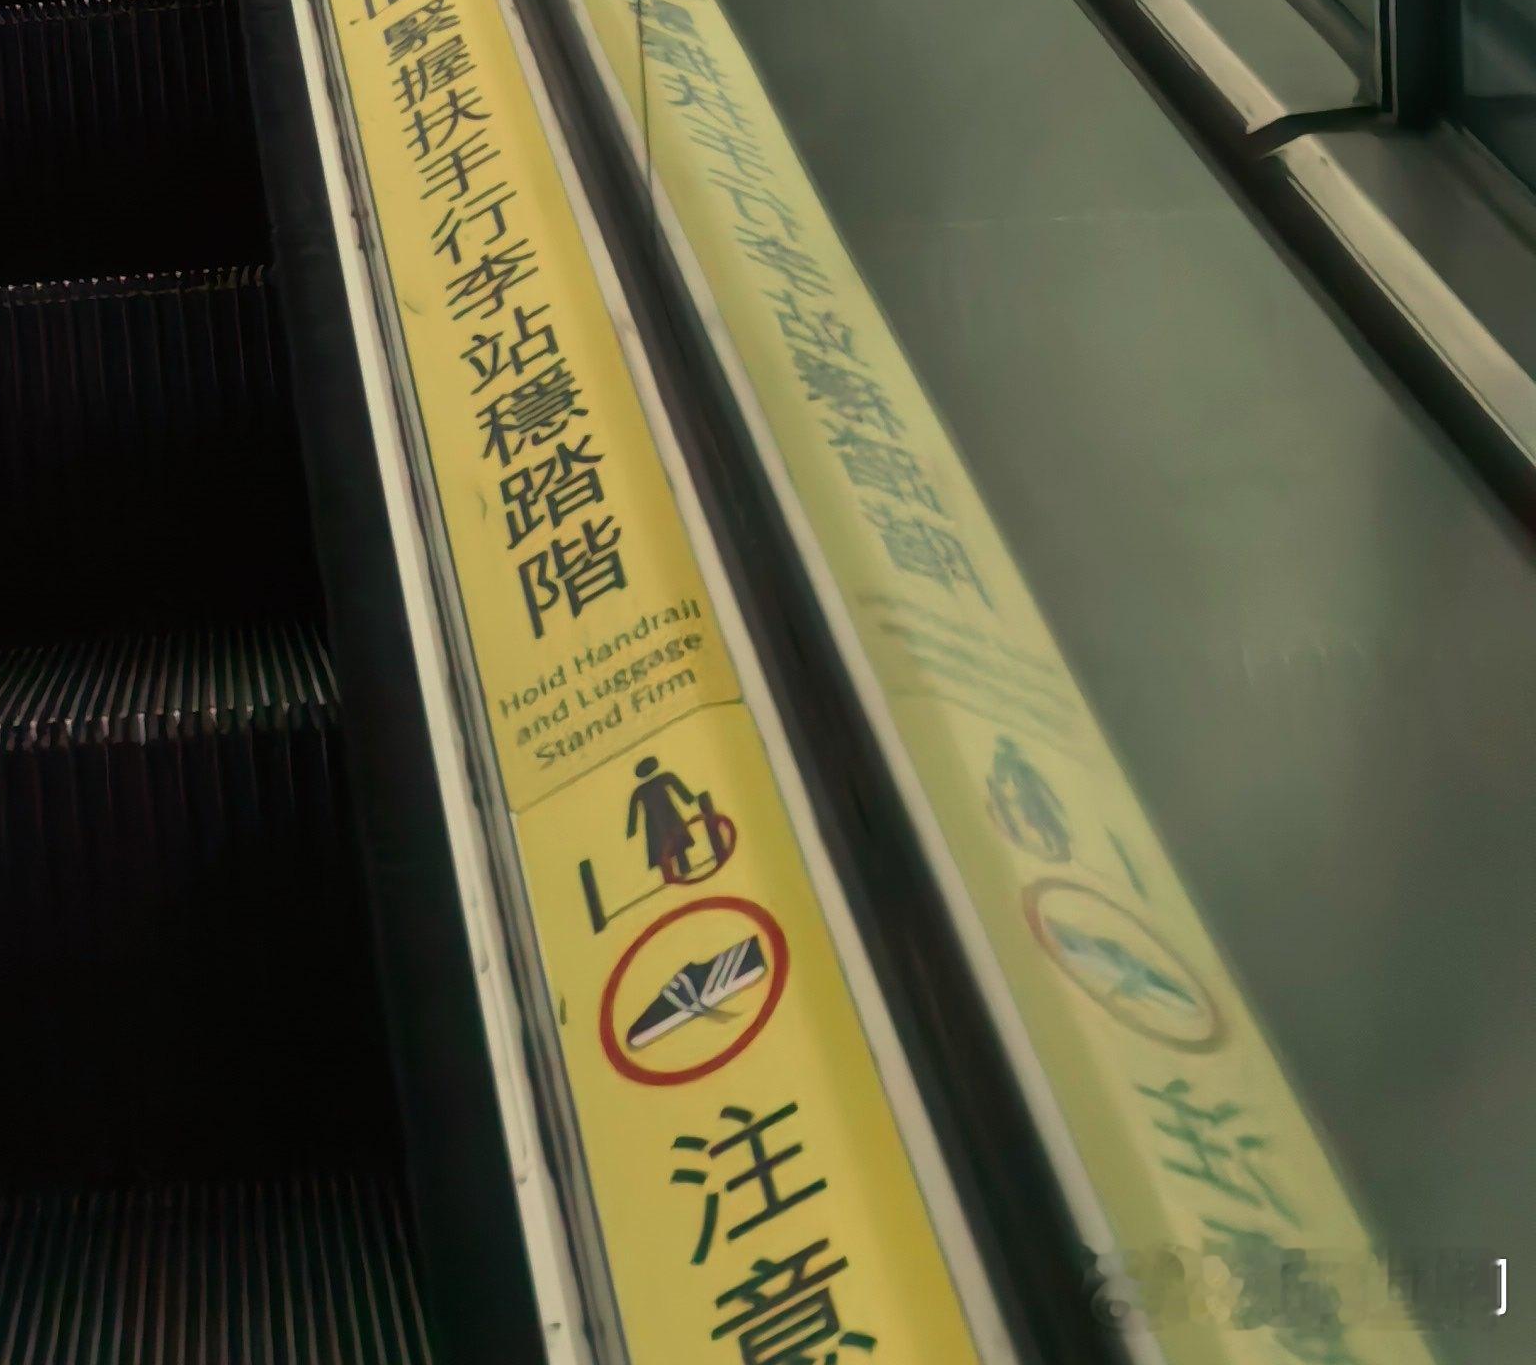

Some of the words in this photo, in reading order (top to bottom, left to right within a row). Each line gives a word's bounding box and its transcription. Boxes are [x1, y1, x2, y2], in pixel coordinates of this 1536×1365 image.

[498, 665, 567, 719] Hold
[573, 599, 701, 674] Handrail
[517, 699, 570, 747] and
[576, 632, 703, 709] Luggage
[535, 703, 622, 769] Stand
[630, 668, 696, 713] Firm
[670, 1102, 877, 1365] 注意
